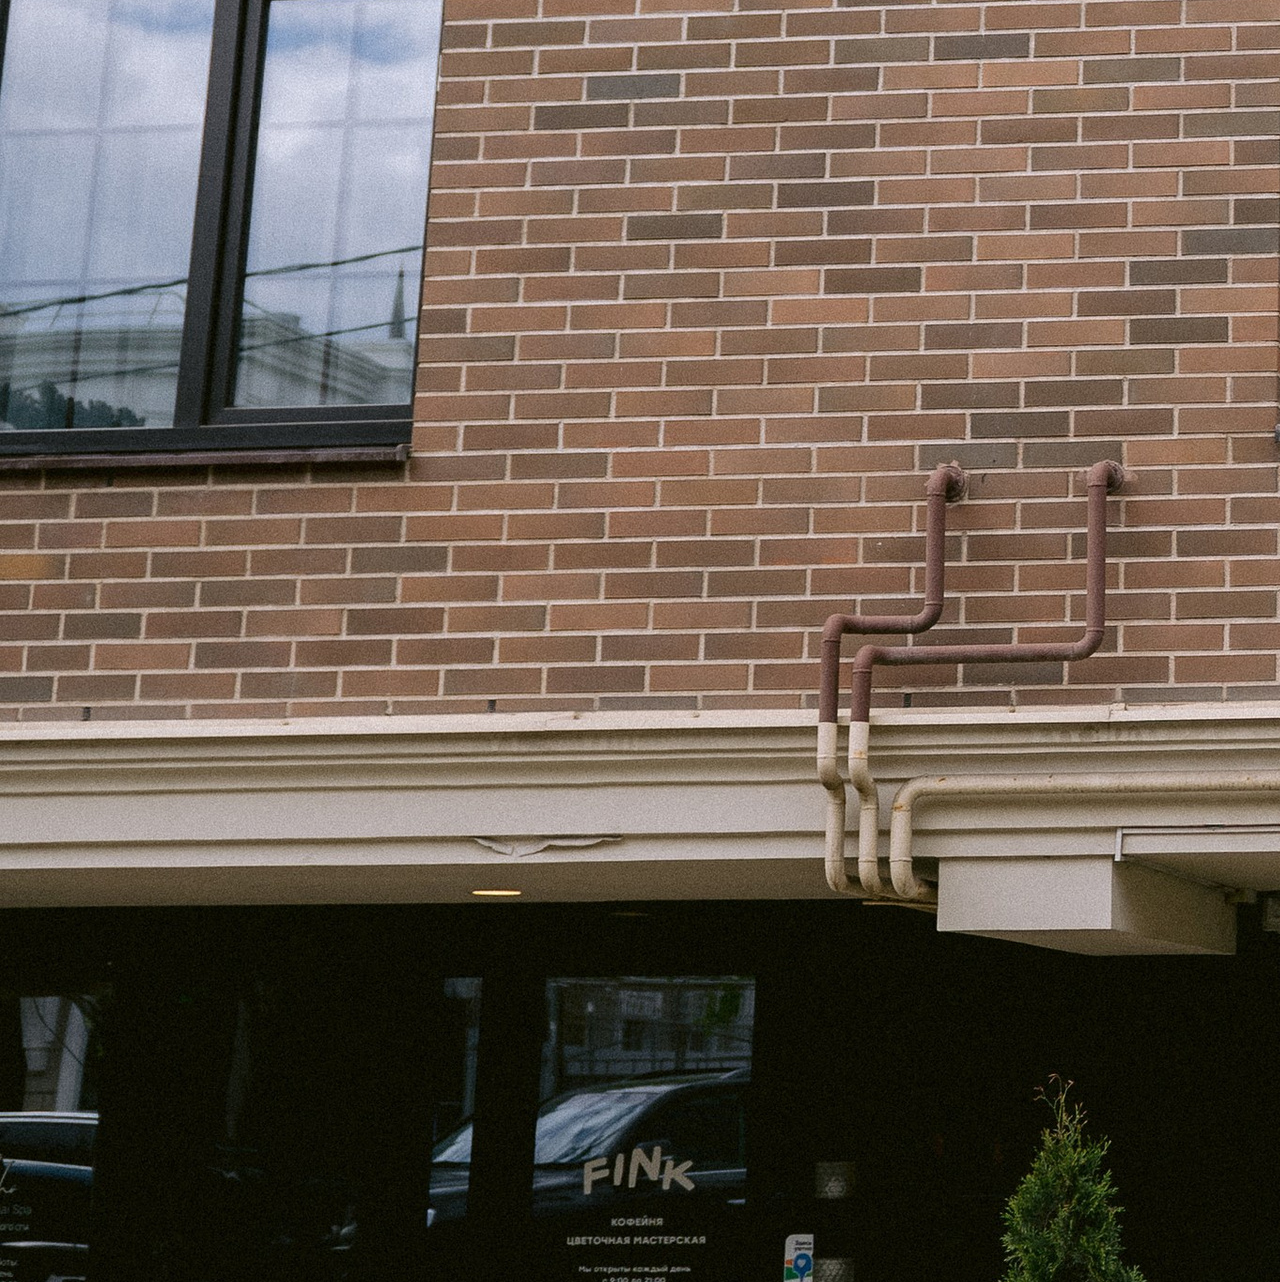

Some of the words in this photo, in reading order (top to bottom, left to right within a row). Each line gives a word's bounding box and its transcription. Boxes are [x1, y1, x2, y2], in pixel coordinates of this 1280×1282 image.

[583, 1145, 696, 1196] FINK
[611, 1214, 665, 1227] КОФЕЙНЯ
[566, 1236, 631, 1246] ЦВЕТОЧНАЯ
[633, 1235, 707, 1245] МАСТЕРСКАЯ
[578, 1265, 592, 1273] Мы
